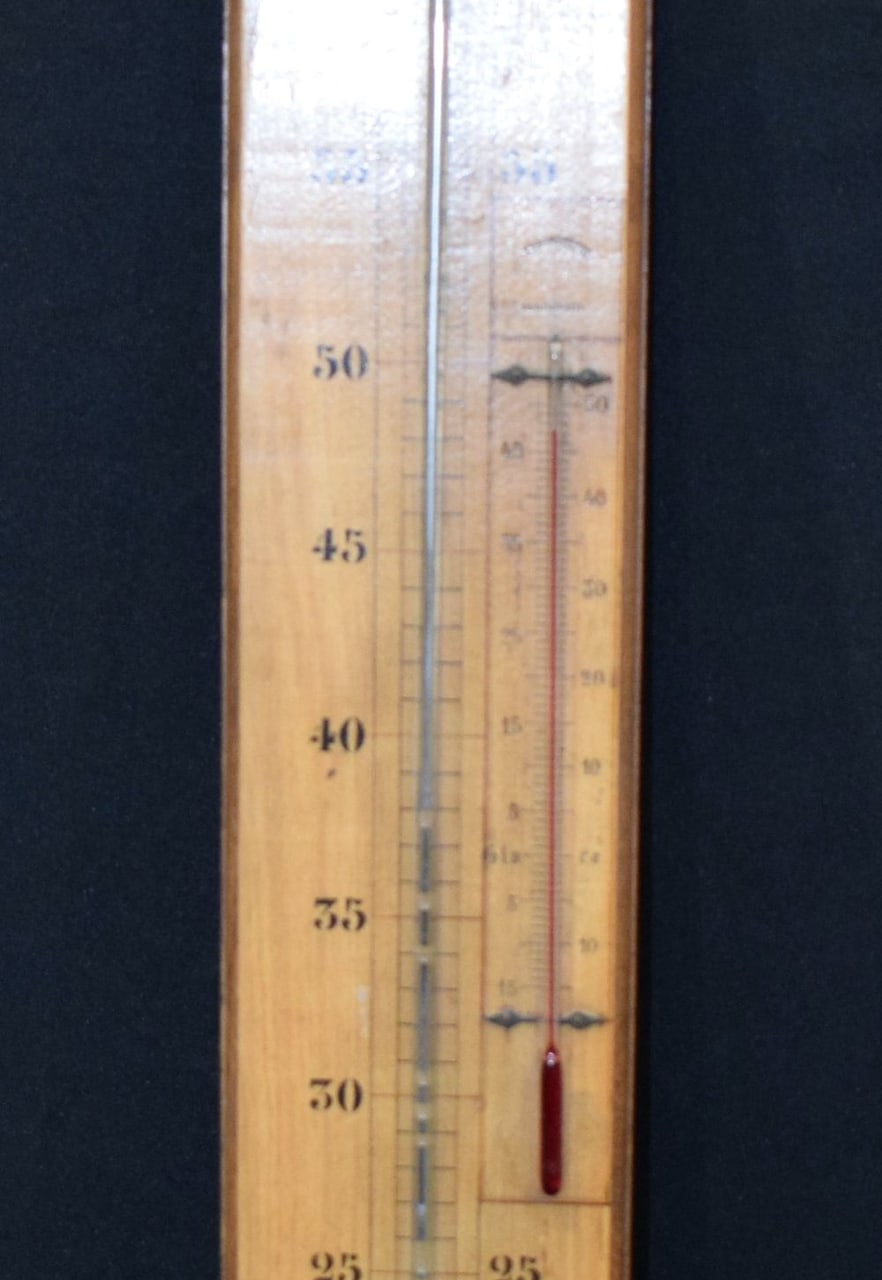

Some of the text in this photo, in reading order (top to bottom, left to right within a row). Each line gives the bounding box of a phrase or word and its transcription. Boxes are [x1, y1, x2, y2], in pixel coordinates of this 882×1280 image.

[314, 344, 369, 380] 50
[312, 527, 367, 563] 45
[310, 717, 365, 753] 40
[313, 897, 367, 932] 35
[309, 1078, 363, 1113] 30
